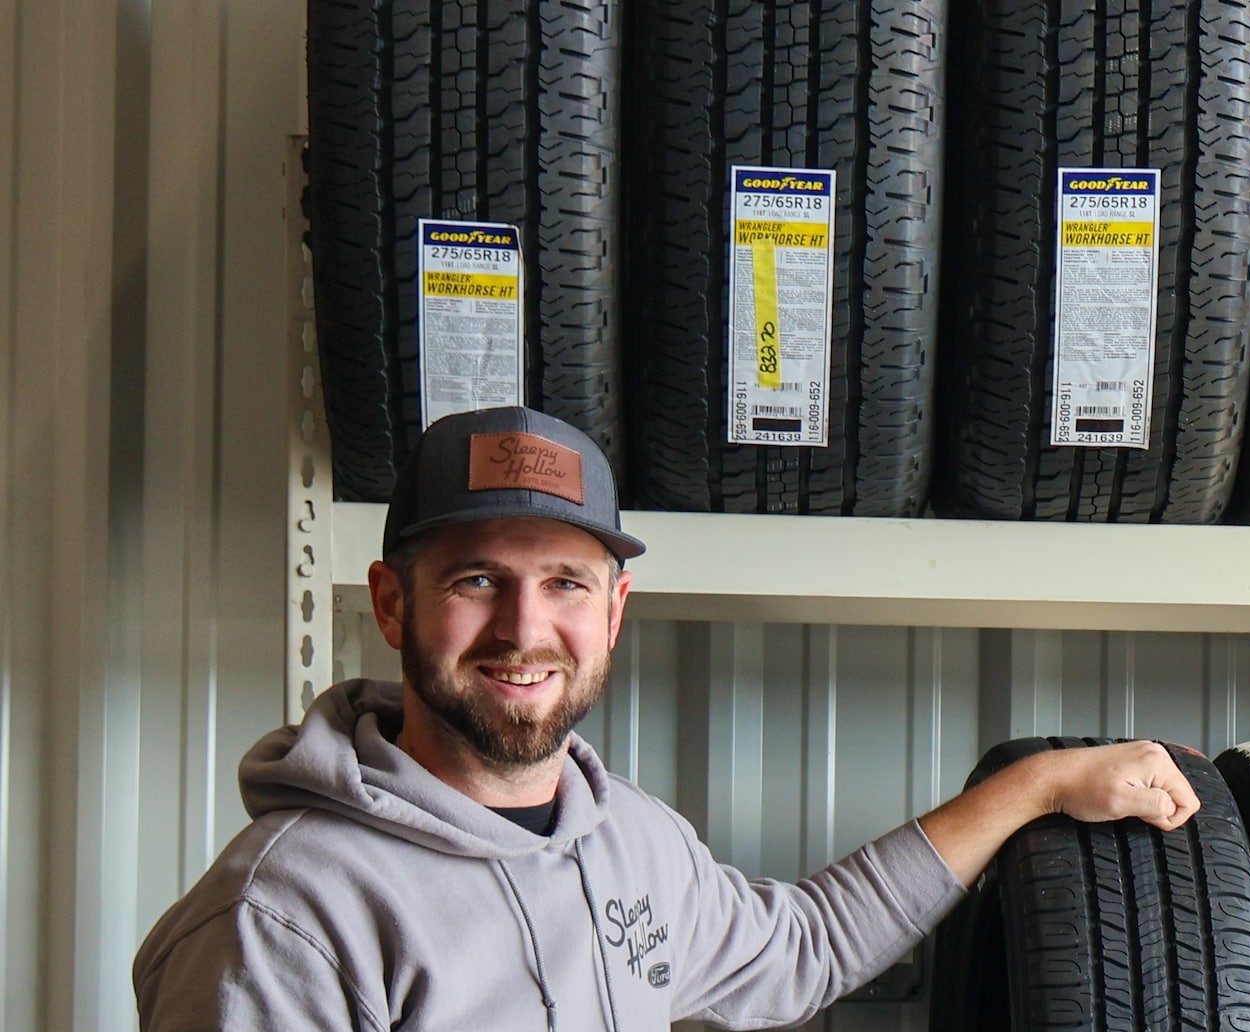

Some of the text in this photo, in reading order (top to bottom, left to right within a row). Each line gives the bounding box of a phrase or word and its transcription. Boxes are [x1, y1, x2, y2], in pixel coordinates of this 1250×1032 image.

[743, 177, 824, 191] GOODYEAR
[1069, 177, 1149, 191] GOODYEAR
[743, 195, 822, 210] 275/65R18
[1070, 196, 1147, 209] 275/65R18
[739, 222, 783, 232] WRANGLER
[1065, 223, 1108, 232] WRANGLER
[430, 231, 512, 245] GOODYEAR
[810, 235, 825, 247] HT
[1066, 233, 1150, 245] WORKHORSE HT
[431, 247, 511, 262] 275/65R18
[427, 272, 471, 283] WRANGLER
[428, 283, 514, 297] WORKHORSE HT
[735, 381, 747, 440] 116-009-652
[809, 381, 821, 440] 116-009-652
[1059, 382, 1072, 442] 116-009-652
[1130, 380, 1144, 442] 116-009-652
[755, 431, 801, 441] 241639
[1077, 433, 1123, 443] 241639
[490, 437, 557, 465] Sleepy
[503, 450, 566, 482] Hollow
[605, 893, 652, 947] Sleepy
[627, 923, 668, 979] Hollow
